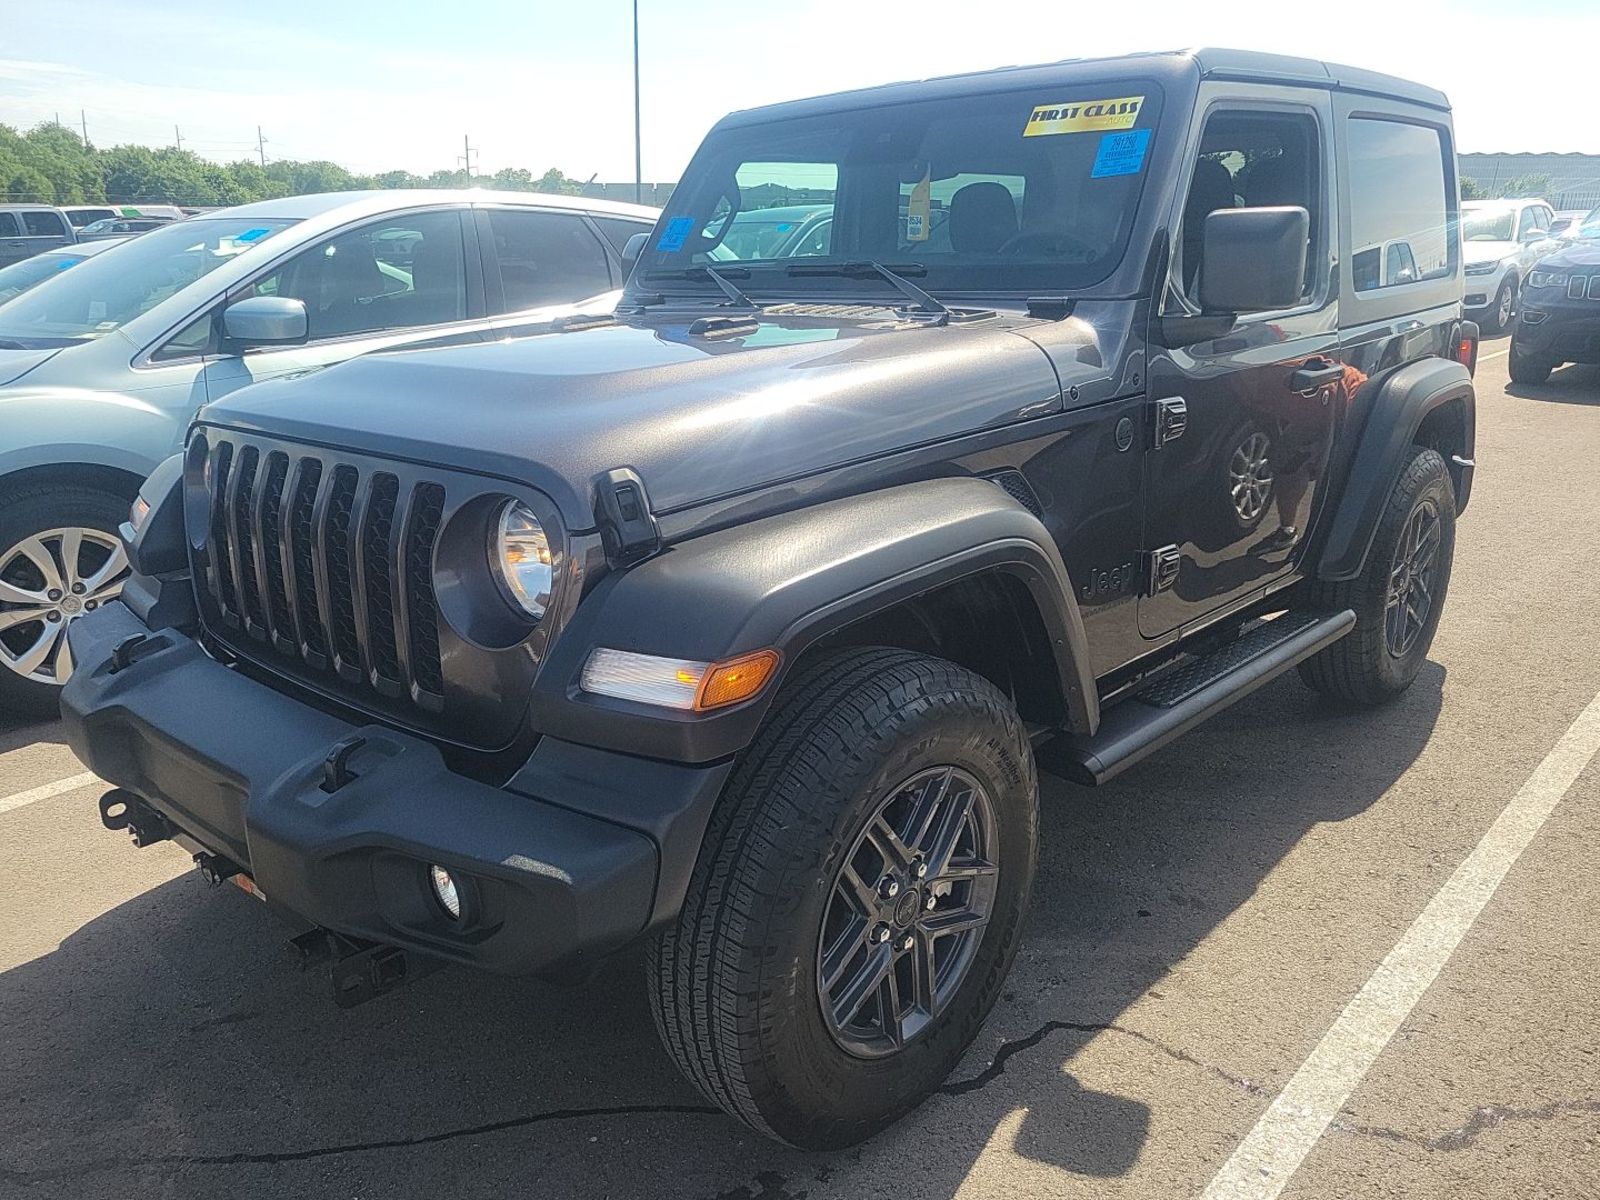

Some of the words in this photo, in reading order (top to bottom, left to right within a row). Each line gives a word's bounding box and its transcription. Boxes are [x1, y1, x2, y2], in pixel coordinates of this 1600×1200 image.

[1030, 107, 1082, 122] FIRST
[1083, 101, 1140, 117] CLASS
[1080, 562, 1132, 600] Jeep
[986, 737, 1021, 785] All-Weather
